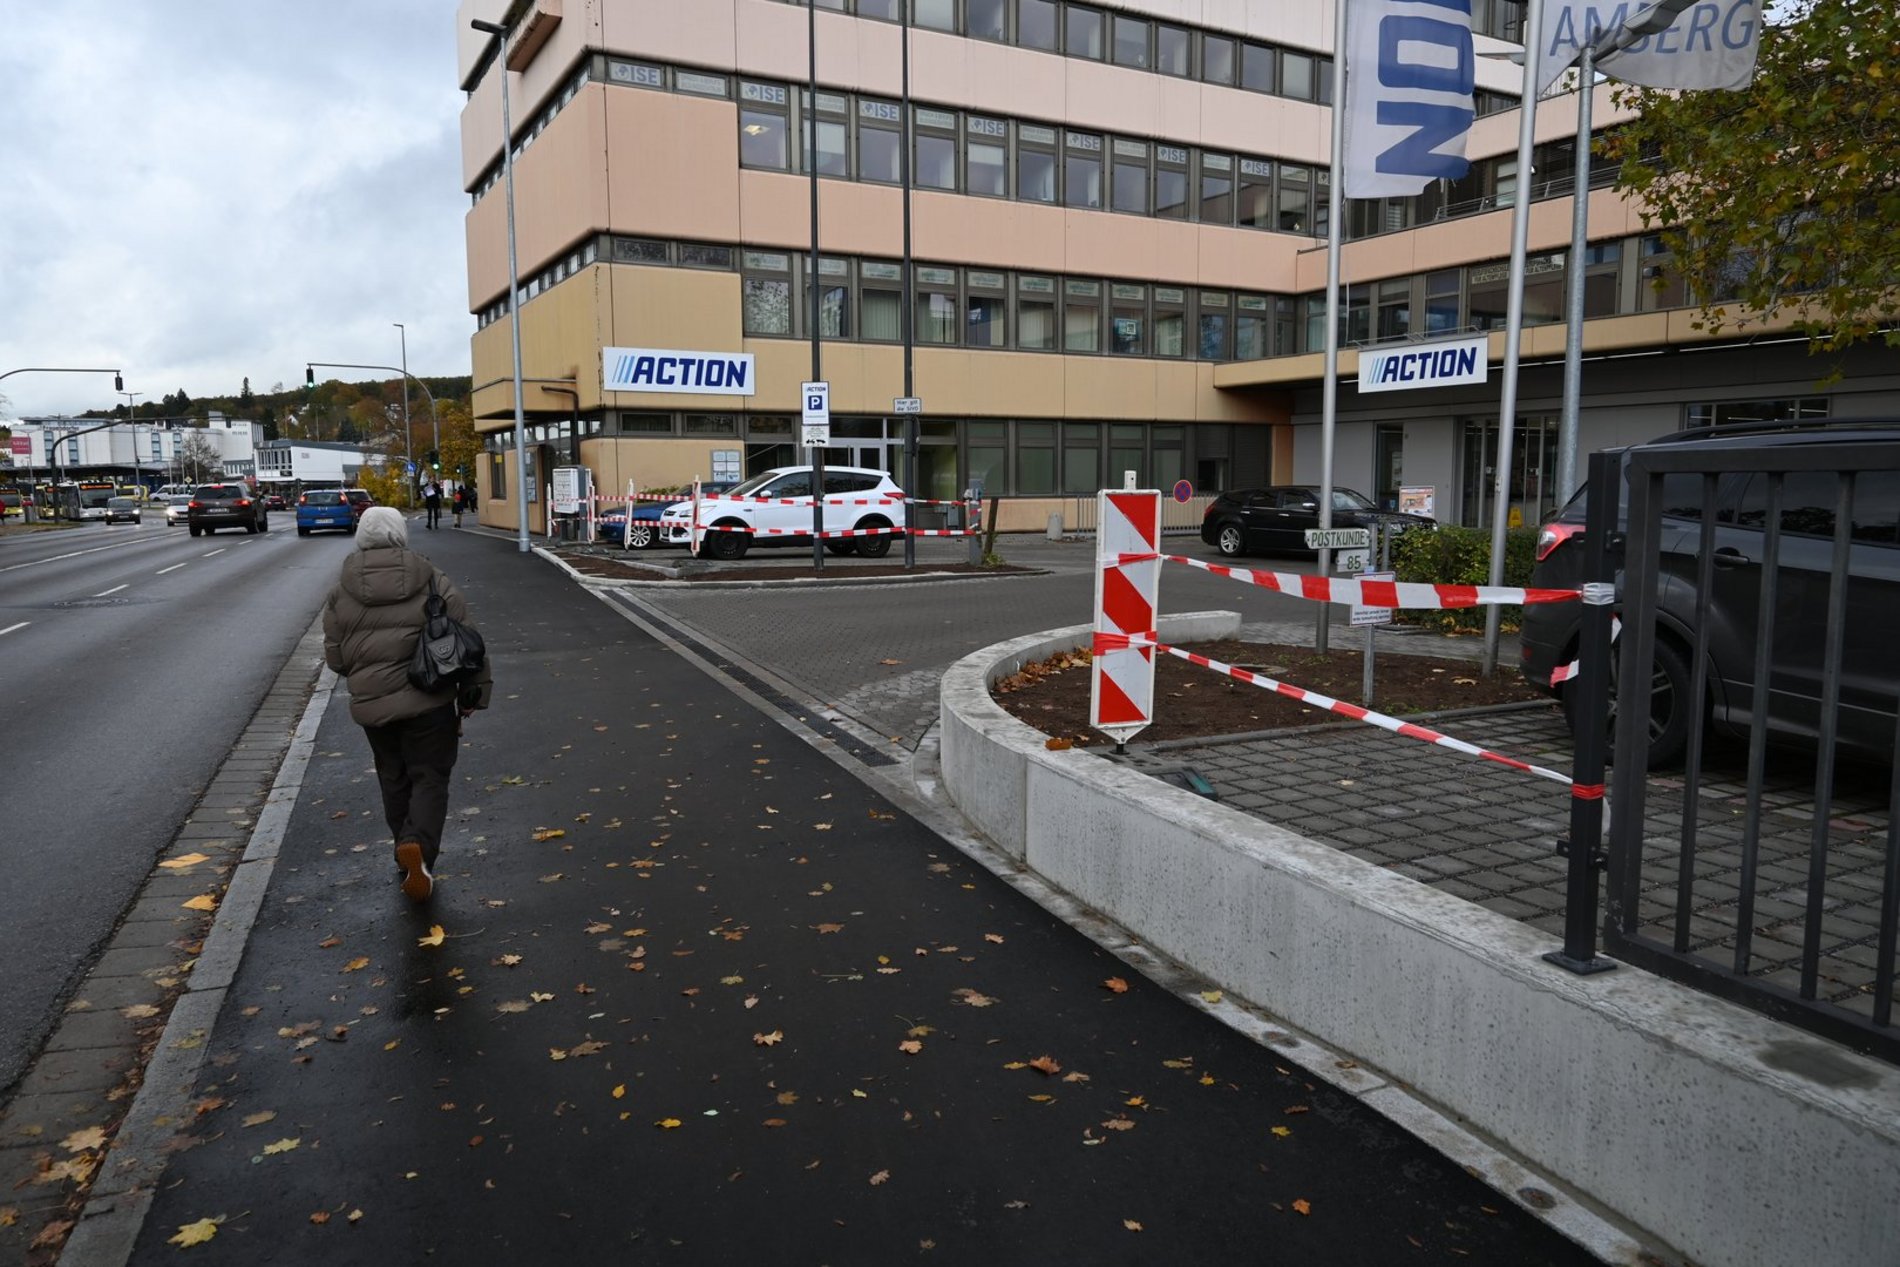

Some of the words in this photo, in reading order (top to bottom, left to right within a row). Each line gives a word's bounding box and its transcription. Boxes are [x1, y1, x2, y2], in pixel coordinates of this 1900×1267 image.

[631, 66, 658, 84] ISE
[759, 88, 785, 103] ISE
[874, 103, 898, 120] ISE
[982, 120, 1005, 137] ISE
[631, 356, 747, 388] ACTION
[1381, 346, 1477, 383] ACTION
[1311, 530, 1366, 547] POSTKUNDE
[1347, 555, 1361, 569] 85
